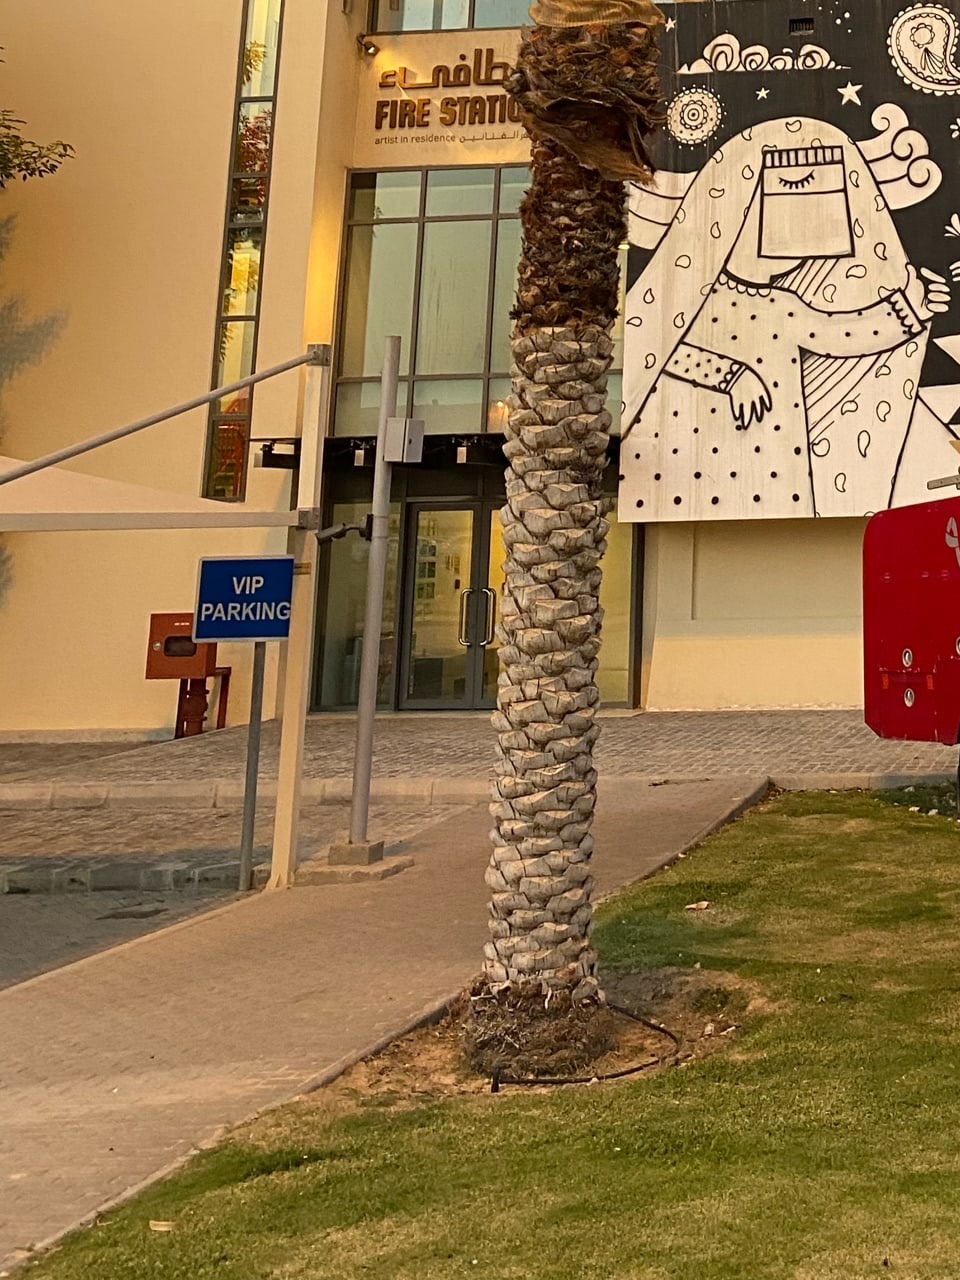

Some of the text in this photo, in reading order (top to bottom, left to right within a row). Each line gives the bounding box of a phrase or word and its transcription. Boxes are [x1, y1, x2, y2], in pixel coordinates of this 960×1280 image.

[375, 94, 524, 130] FIRE STATIO
[374, 134, 456, 145] artist in residence
[232, 576, 265, 595] VIP
[200, 601, 291, 622] PARKING
